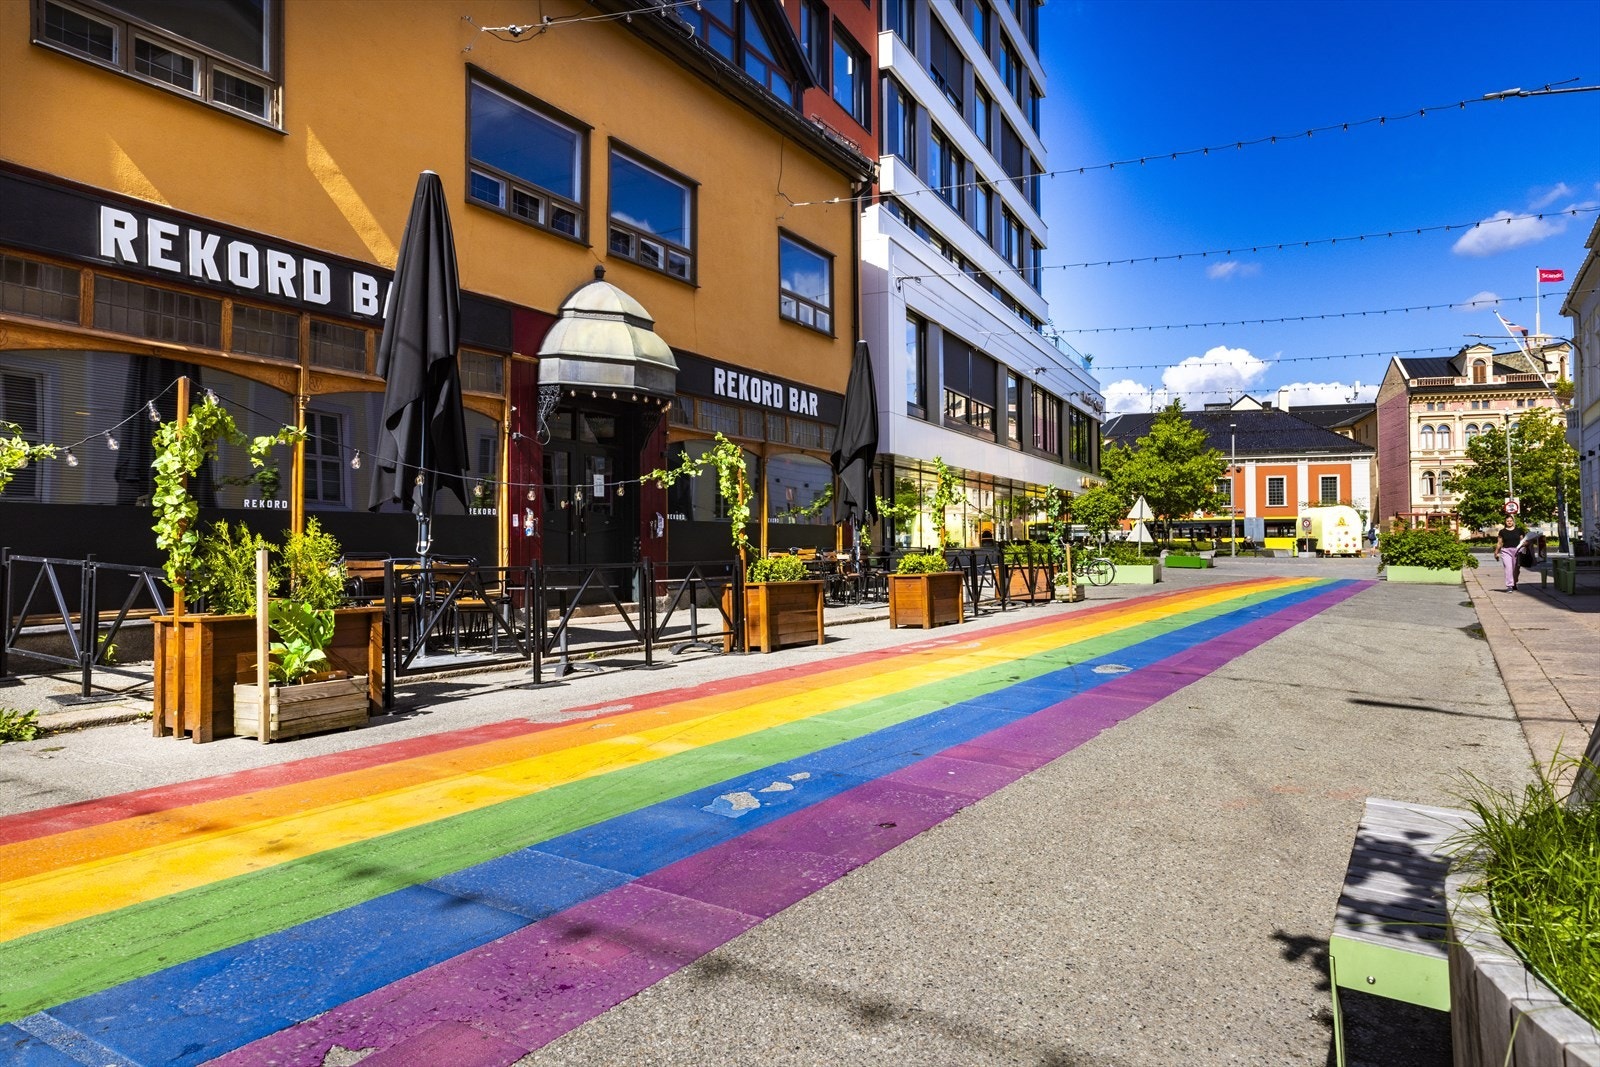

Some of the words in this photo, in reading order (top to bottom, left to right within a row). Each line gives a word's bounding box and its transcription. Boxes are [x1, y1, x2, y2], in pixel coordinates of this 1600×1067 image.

[101, 205, 331, 305] REKORD
[714, 367, 783, 409] REKORD
[789, 387, 818, 417] BAR
[243, 499, 288, 509] REKORD
